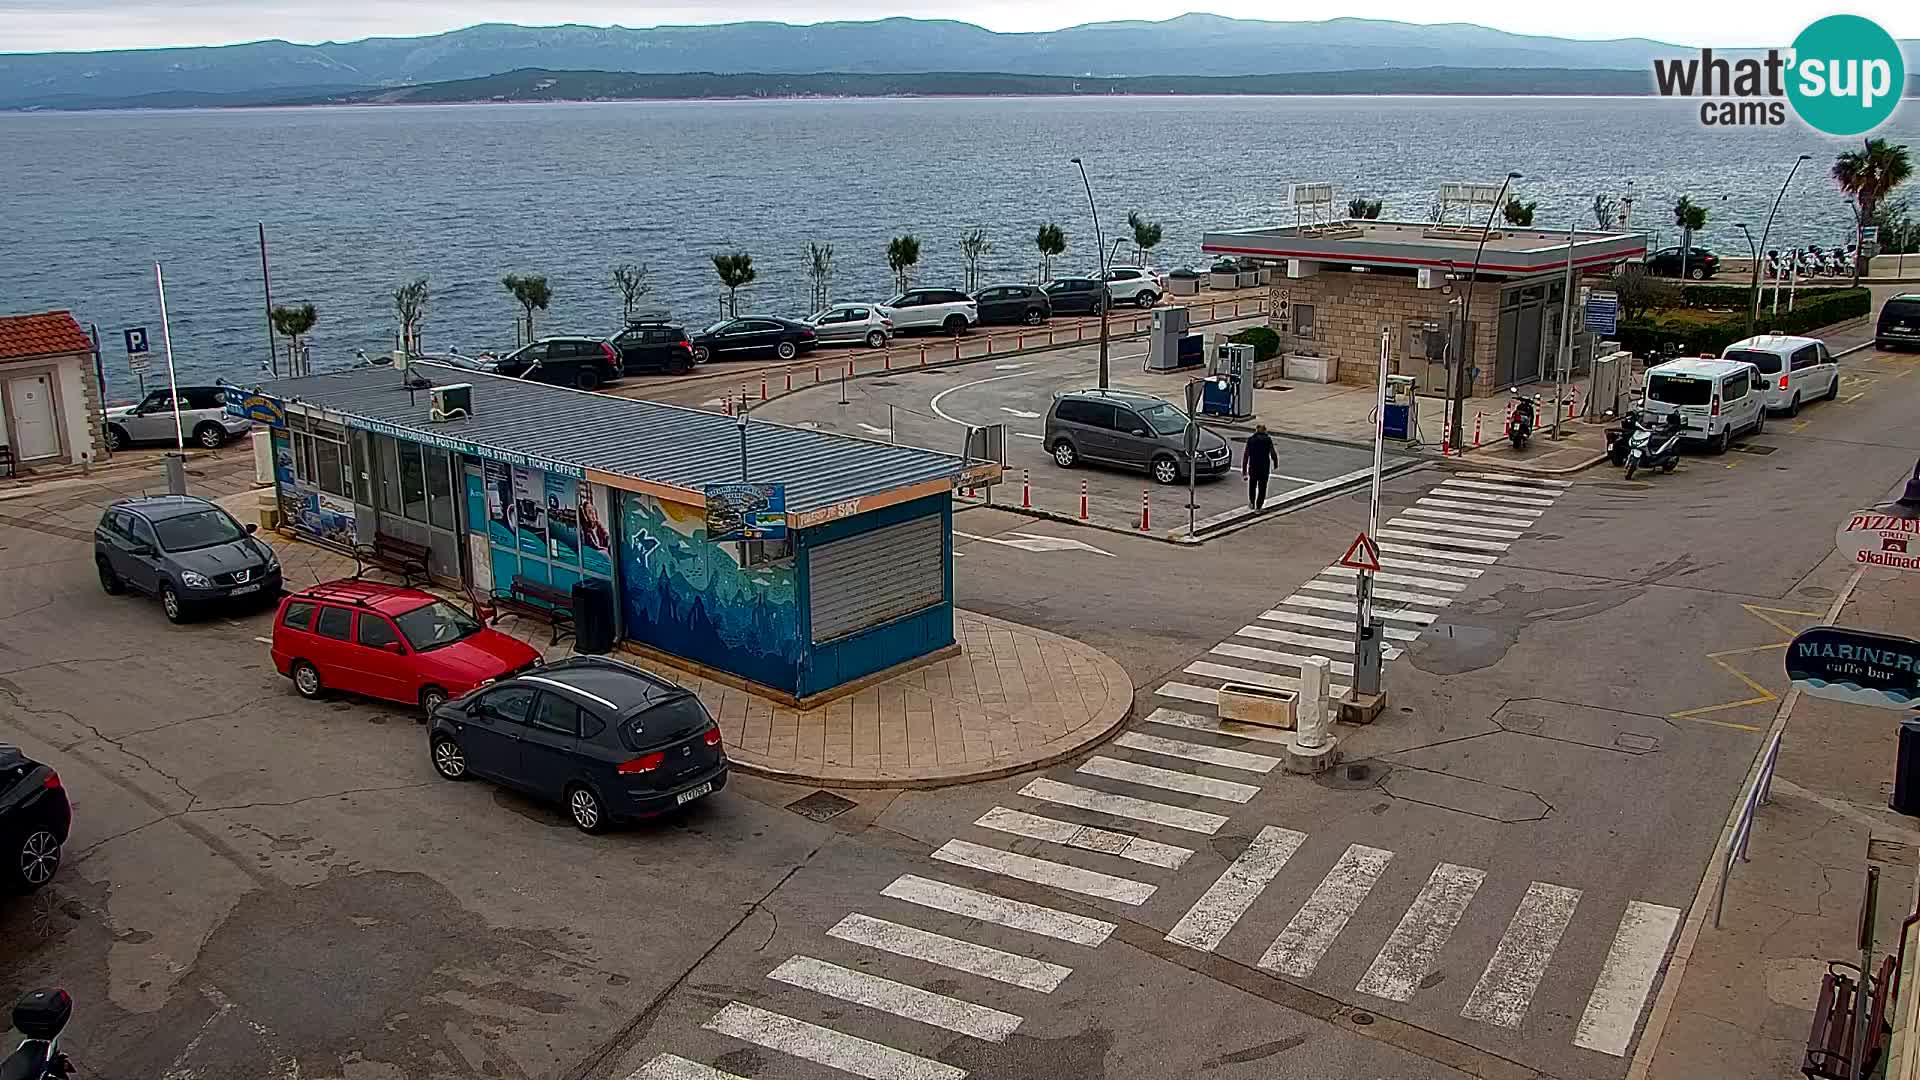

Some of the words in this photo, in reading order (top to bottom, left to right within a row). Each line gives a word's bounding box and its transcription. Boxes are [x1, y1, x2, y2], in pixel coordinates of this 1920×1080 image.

[130, 331, 142, 350] P
[477, 446, 492, 459] BUS
[493, 450, 526, 464] STATION
[527, 457, 553, 471] TICKET
[555, 463, 581, 477] OFFICE
[1879, 531, 1912, 541] GRILL
[1826, 662, 1863, 674] caffe
[1868, 666, 1894, 680] bar
